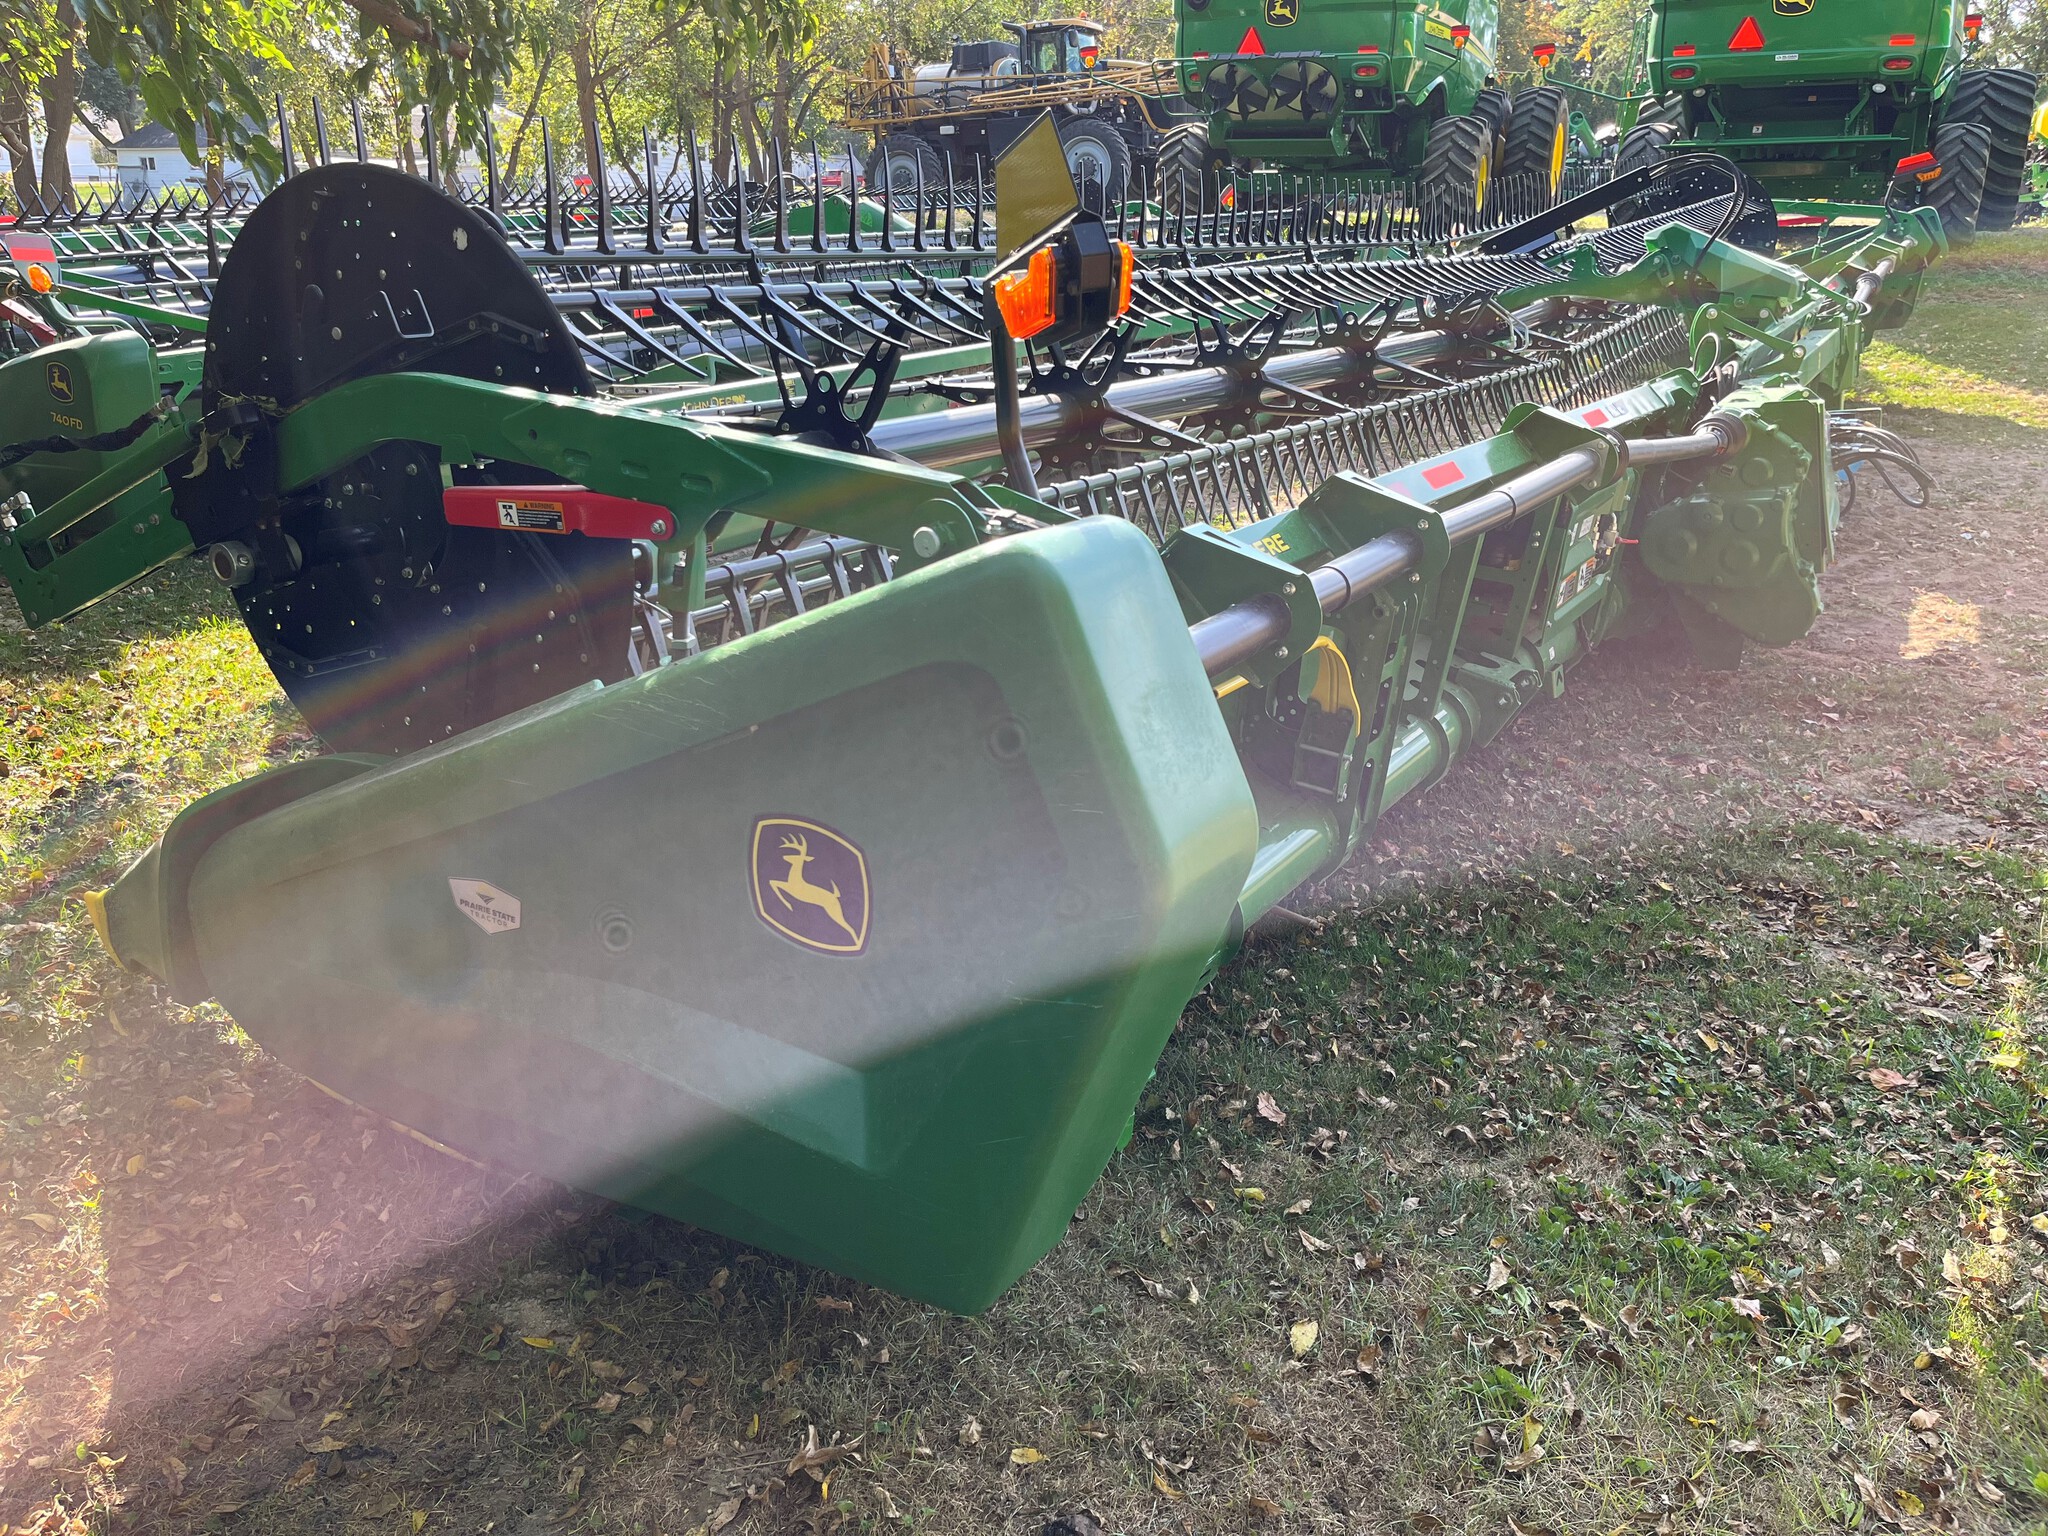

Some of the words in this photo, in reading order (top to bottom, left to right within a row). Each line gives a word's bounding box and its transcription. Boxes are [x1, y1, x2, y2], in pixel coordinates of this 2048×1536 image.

[50, 411, 83, 430] 740FD
[459, 898, 492, 915] PRAIRIE
[491, 909, 516, 924] STATE
[470, 909, 508, 927] TRACTOR
